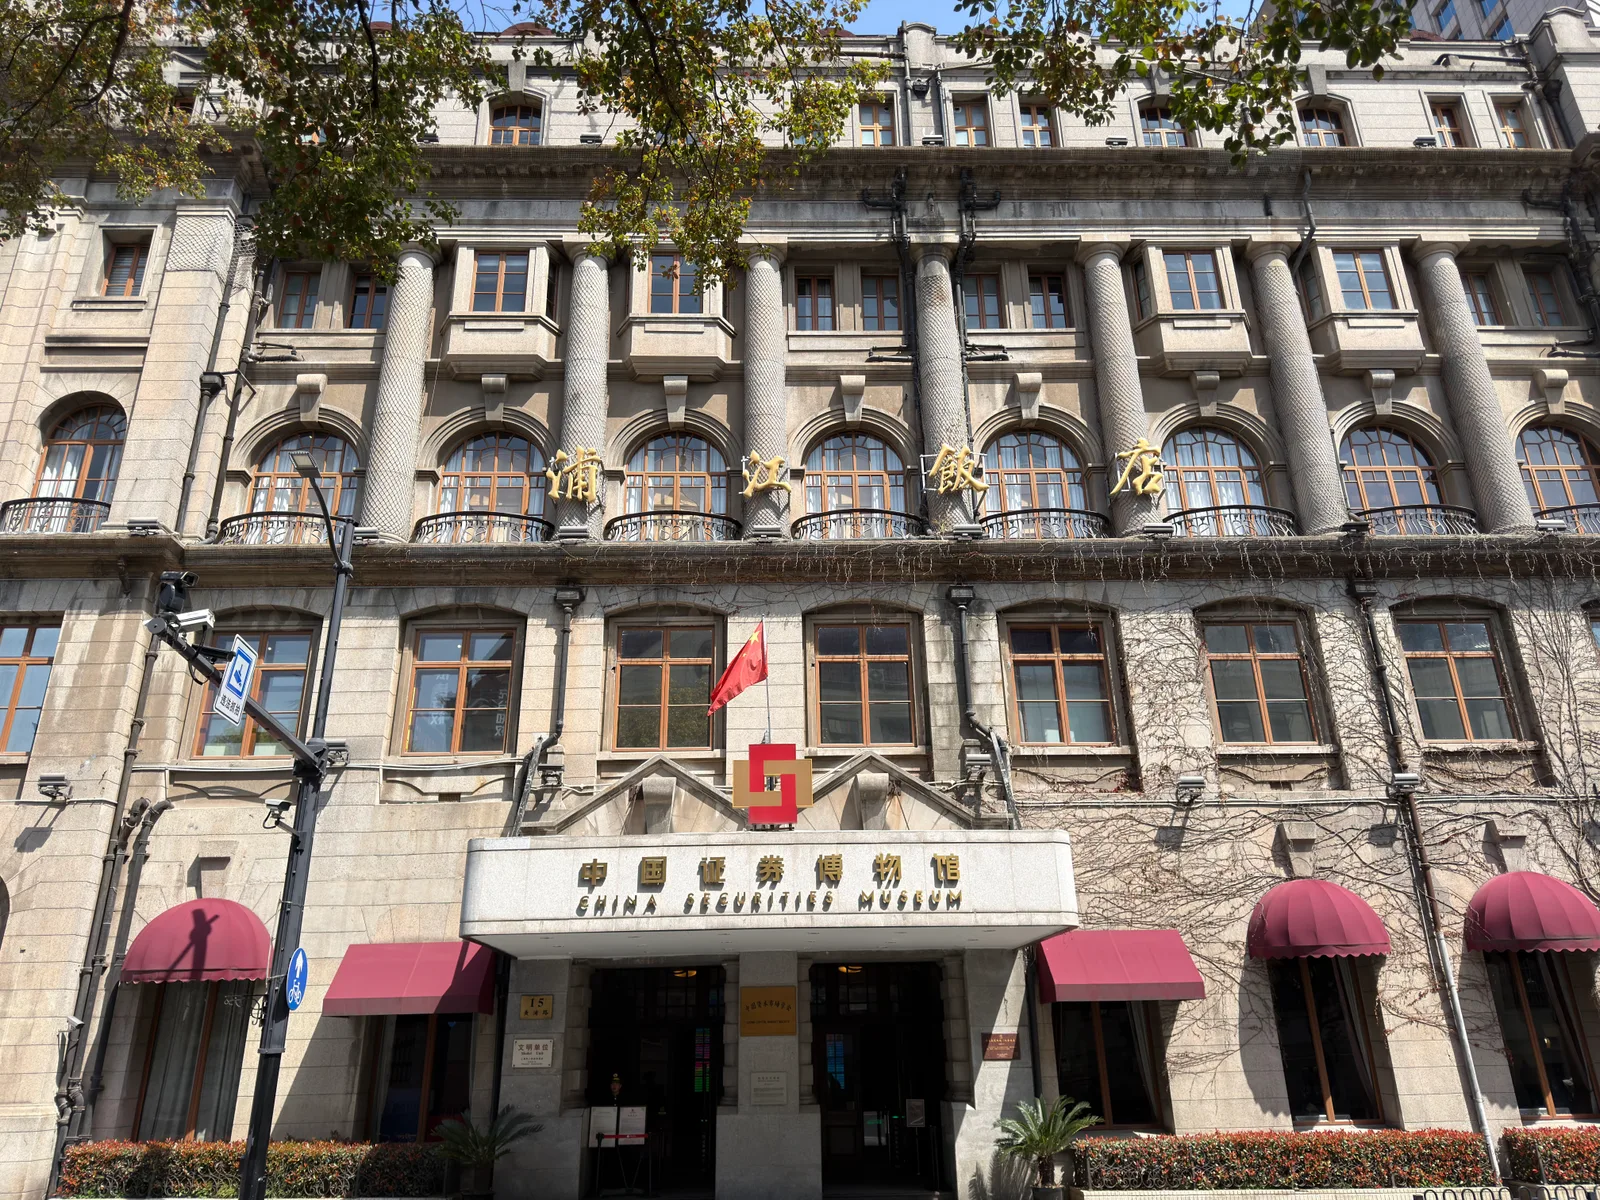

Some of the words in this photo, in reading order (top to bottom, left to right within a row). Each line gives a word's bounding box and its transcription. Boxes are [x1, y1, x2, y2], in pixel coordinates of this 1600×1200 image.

[581, 853, 961, 886] 中国证券博物馆
[579, 894, 658, 910] CHINA
[686, 890, 834, 906] SECURITIES
[861, 889, 963, 904] MUSEUM
[530, 998, 545, 1008] 15
